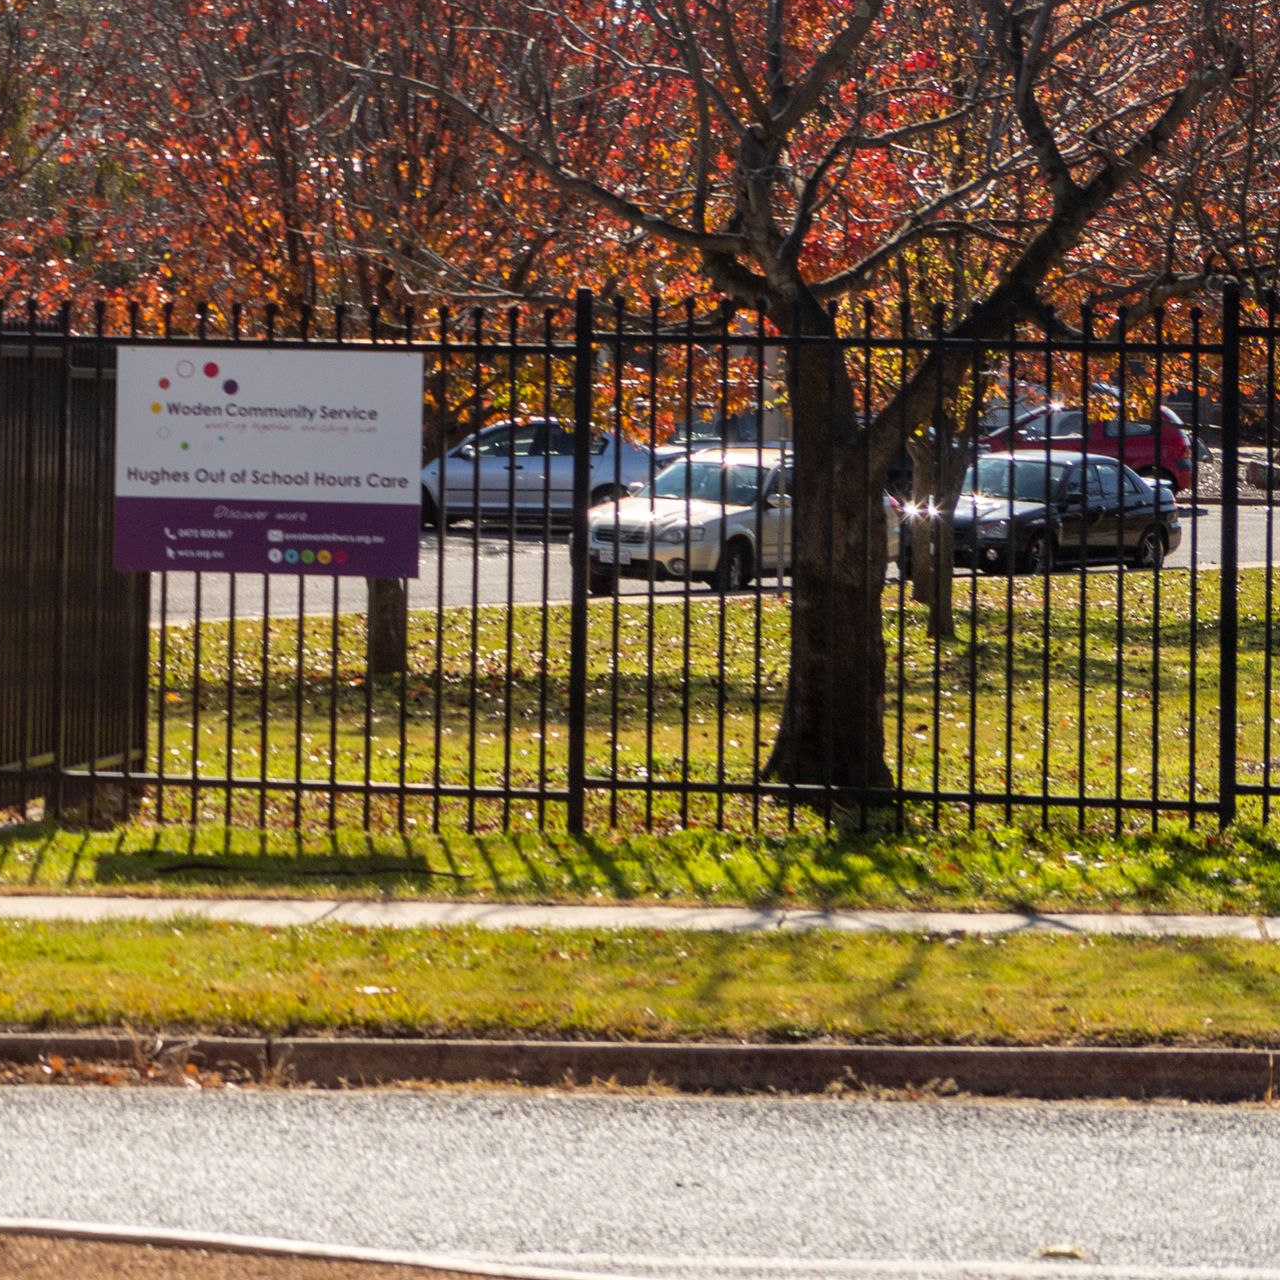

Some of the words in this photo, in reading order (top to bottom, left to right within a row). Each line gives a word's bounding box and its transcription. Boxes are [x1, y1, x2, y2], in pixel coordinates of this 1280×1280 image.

[166, 401, 222, 418] Woden
[225, 402, 317, 421] Community
[319, 405, 379, 421] Service
[126, 466, 190, 485] Hughes
[194, 467, 225, 484] Out
[229, 467, 247, 484] of
[251, 468, 309, 486] School
[313, 470, 362, 487] Hours
[366, 472, 409, 489] Care
